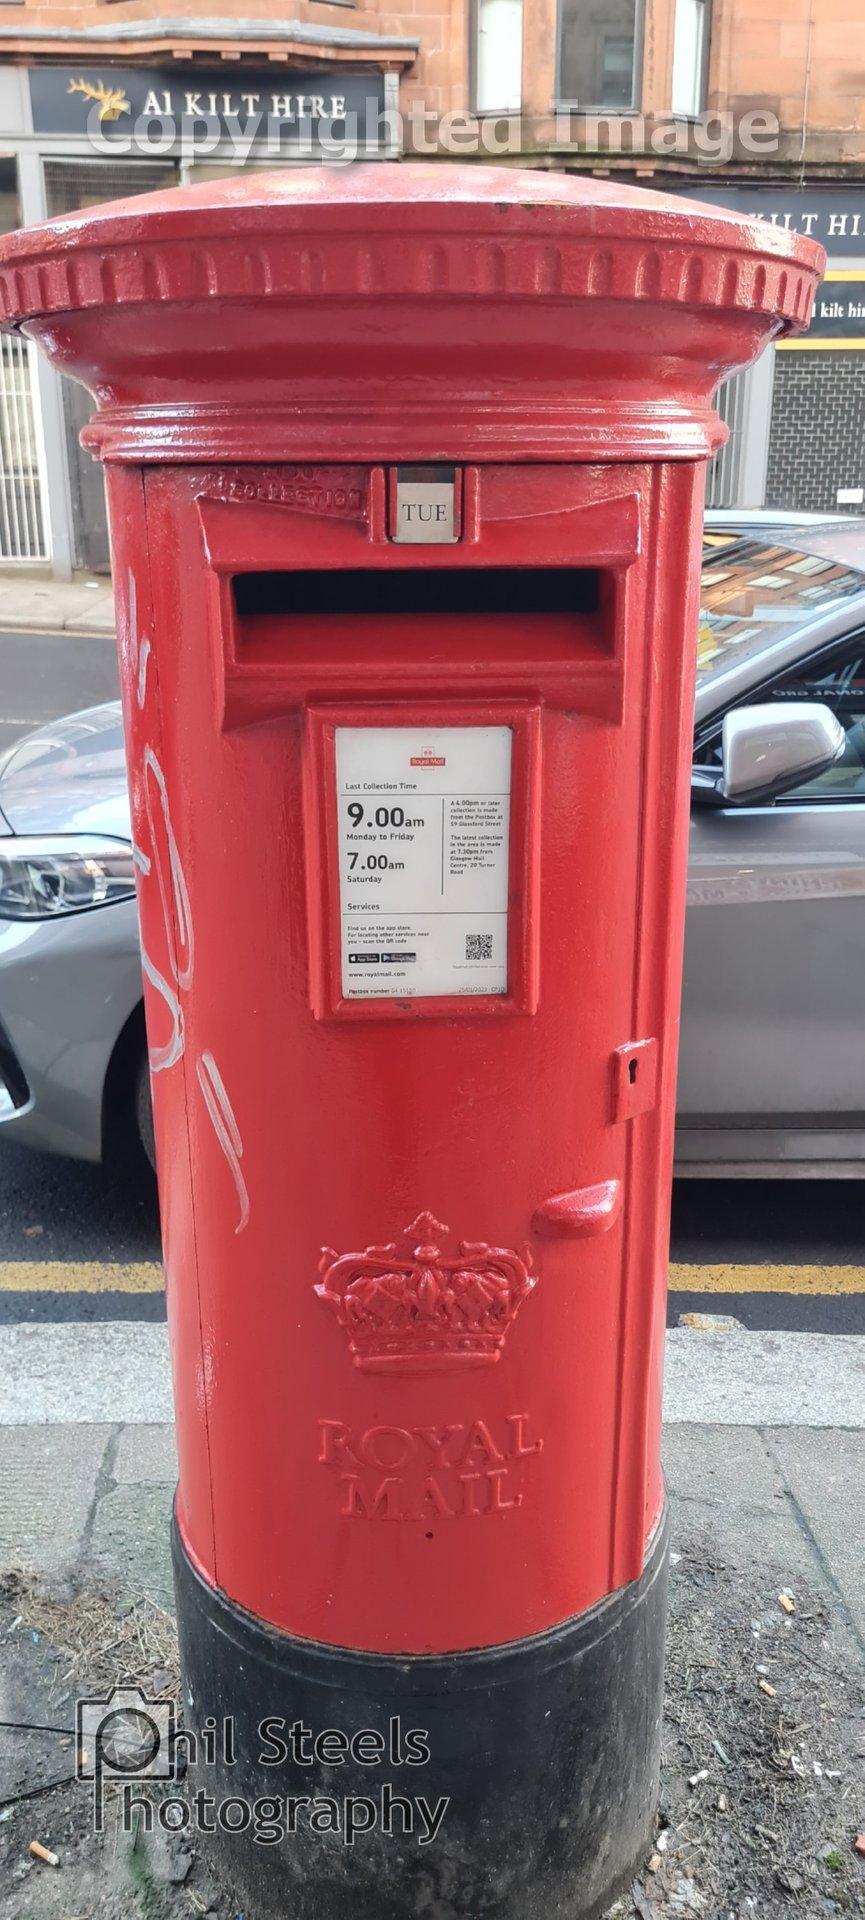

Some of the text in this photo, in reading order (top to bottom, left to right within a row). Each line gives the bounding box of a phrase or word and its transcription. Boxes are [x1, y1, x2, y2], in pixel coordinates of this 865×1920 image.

[184, 92, 261, 117] KILT
[271, 94, 347, 119] HIRE
[827, 214, 865, 236] HI
[820, 302, 844, 318] kilt
[402, 504, 447, 522] TUE
[412, 758, 429, 766] Royal
[363, 782, 398, 790] Collection
[400, 782, 418, 790] Time
[347, 802, 425, 828] 9.00am
[346, 832, 415, 842] Monday to Friday
[347, 852, 405, 870] 7.00am
[347, 876, 382, 884] Saturday
[347, 902, 381, 911] Services
[317, 1413, 544, 1470] ROYAL
[339, 1468, 523, 1521] MAIL
